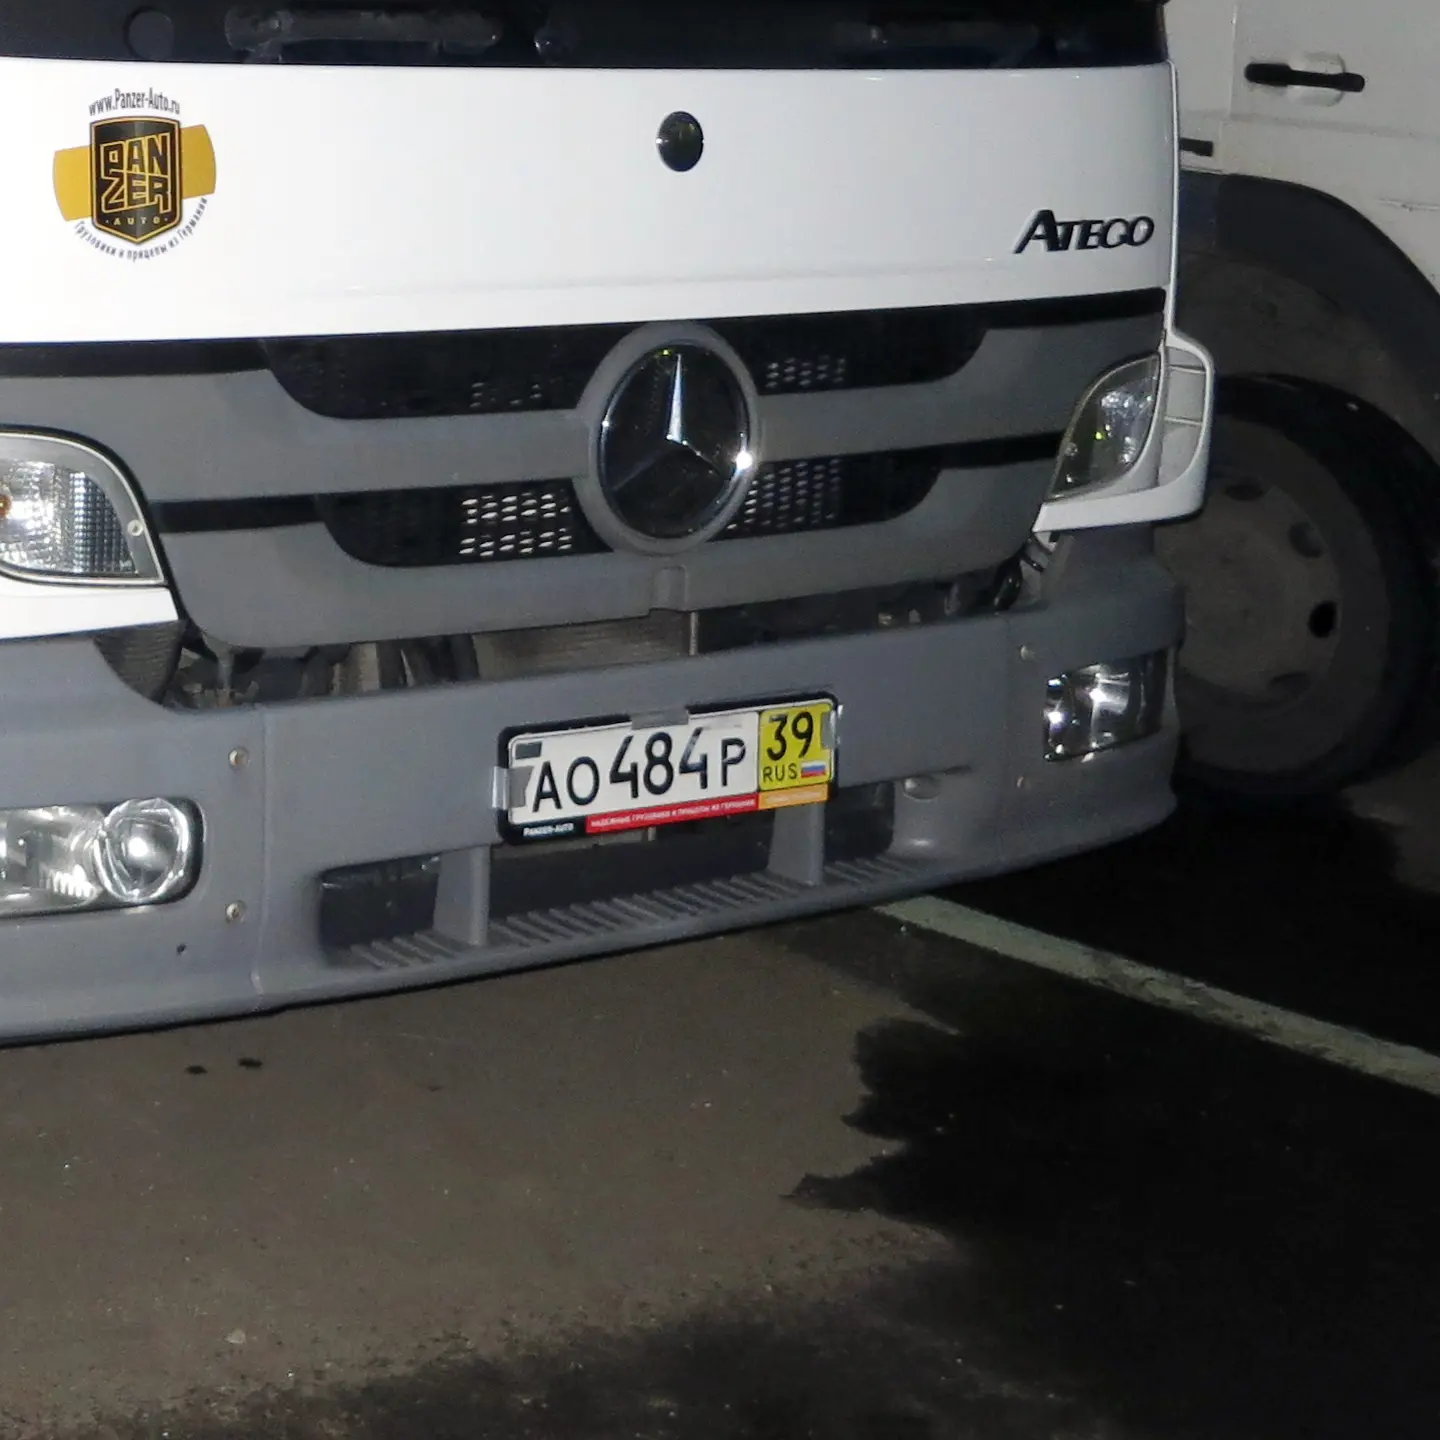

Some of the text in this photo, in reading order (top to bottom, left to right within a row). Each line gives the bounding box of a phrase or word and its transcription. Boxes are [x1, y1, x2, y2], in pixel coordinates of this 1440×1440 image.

[89, 87, 180, 116] www.Panzer-Auto.ru
[113, 216, 161, 226] AUTO
[766, 711, 814, 761] 39
[762, 762, 798, 782] RUS
